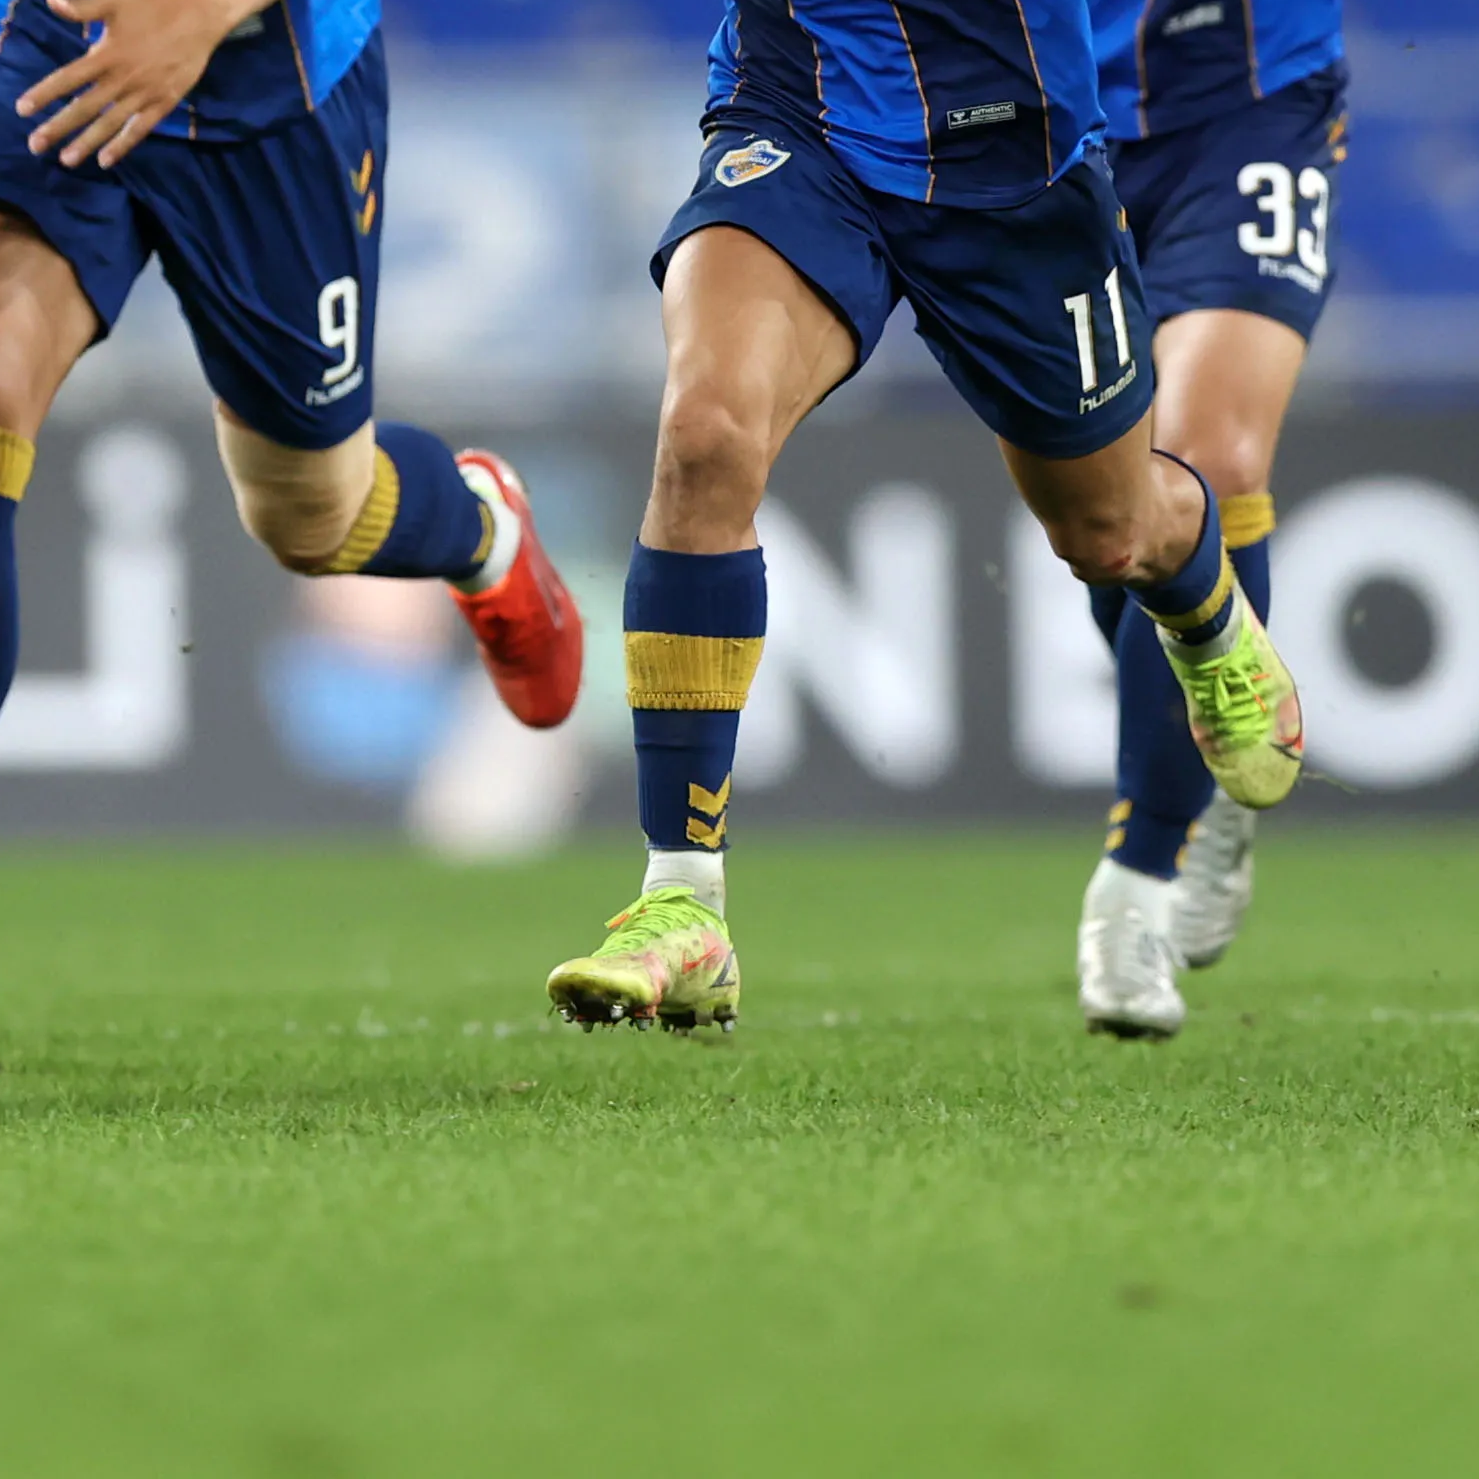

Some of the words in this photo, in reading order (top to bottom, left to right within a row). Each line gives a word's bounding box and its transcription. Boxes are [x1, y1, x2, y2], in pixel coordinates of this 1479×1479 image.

[971, 104, 1013, 116] AUTHENTIC
[1237, 161, 1329, 278] 33
[318, 275, 358, 386] 9
[1063, 265, 1131, 393] 11
[1079, 359, 1137, 415] hummel
